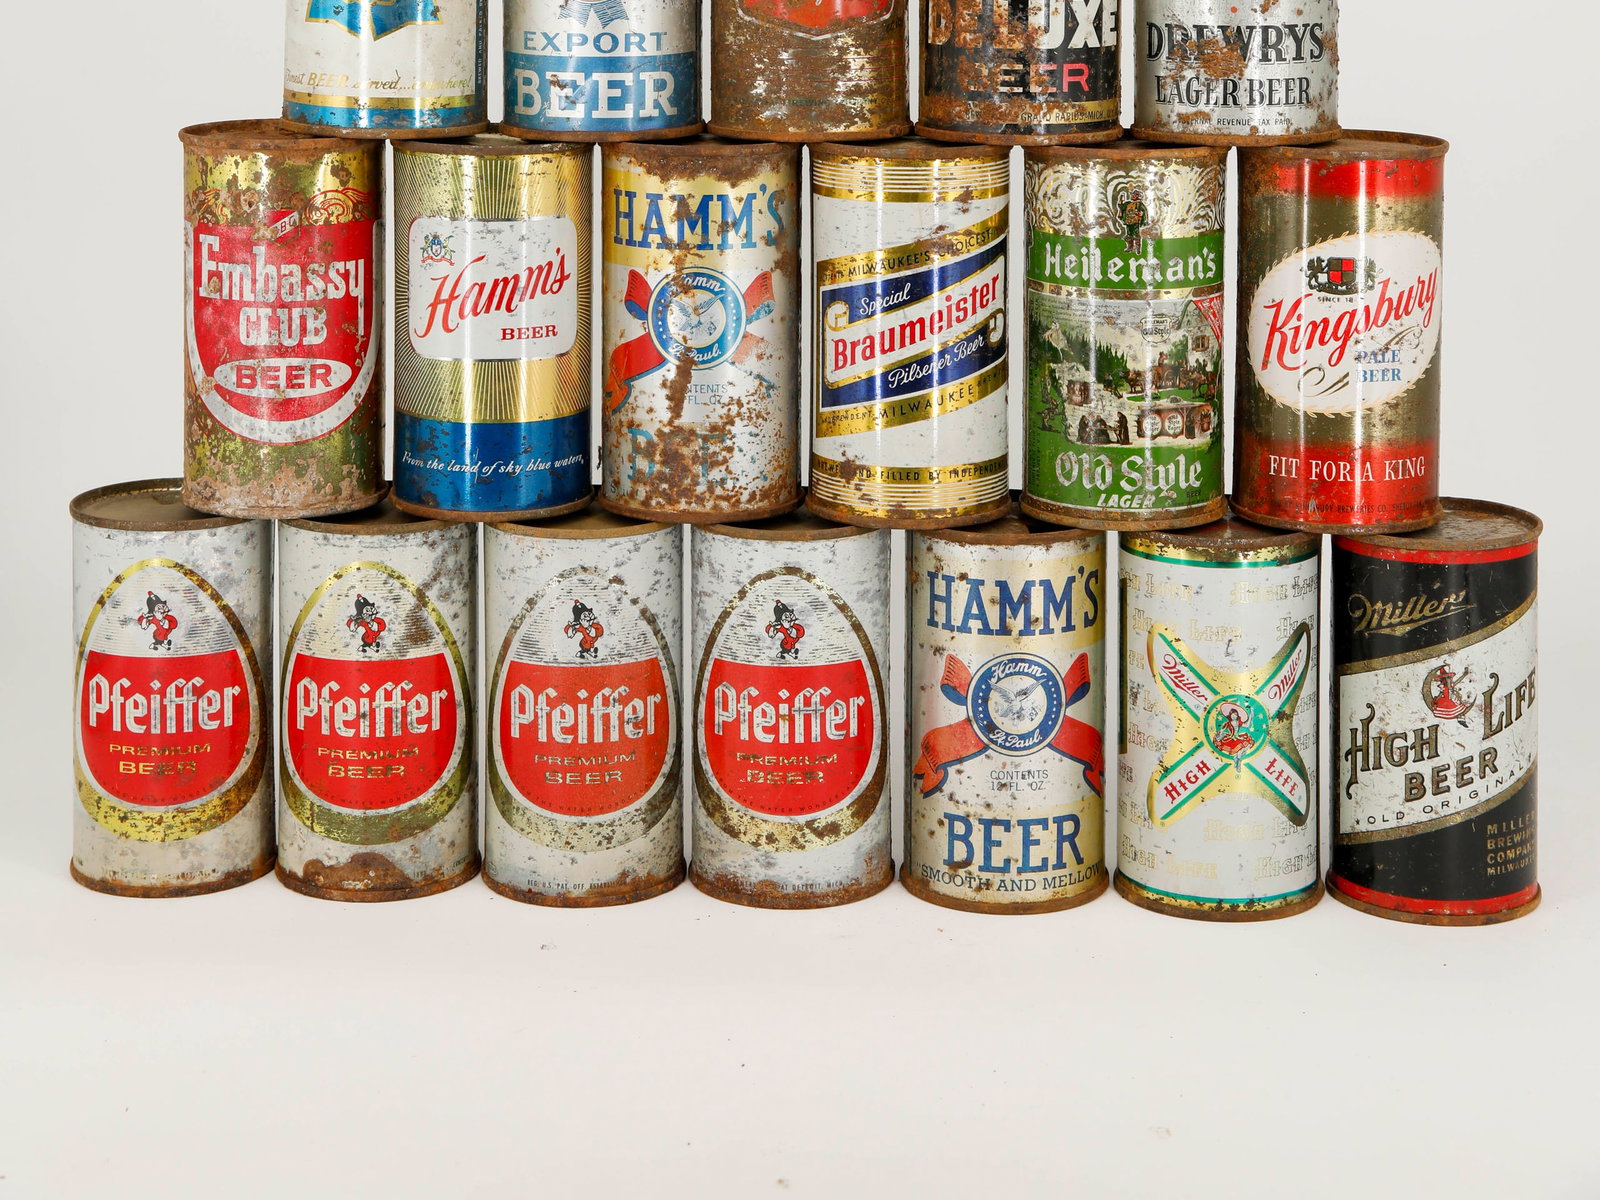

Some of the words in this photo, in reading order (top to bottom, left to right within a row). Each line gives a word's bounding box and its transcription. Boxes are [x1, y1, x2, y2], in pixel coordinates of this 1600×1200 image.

[523, 30, 668, 53] EXPORT
[308, 72, 349, 87] BEER
[514, 68, 677, 119] BEER
[956, 62, 1090, 93] BEER
[1155, 75, 1241, 108] LAGER
[1247, 76, 1312, 108] BEER
[613, 183, 785, 250] HAMM'S
[848, 251, 931, 277] MILWAUKEE'S
[1044, 241, 1216, 283] Heileman's
[199, 234, 364, 336] Embassy
[414, 247, 571, 339] Hamm's
[859, 282, 910, 316] Special
[239, 306, 327, 347] CLUB
[501, 325, 558, 340] BEER
[832, 273, 1000, 373] Braumeister
[1261, 268, 1438, 372] Kingsbury
[888, 352, 953, 389] Pilsener
[953, 334, 985, 362] Beer
[1355, 350, 1401, 364] PALE
[235, 363, 333, 390] BEER
[1357, 368, 1402, 383] BEER
[878, 384, 974, 419] MILWAUKEE
[402, 451, 424, 467] From
[426, 459, 444, 471] the
[447, 461, 481, 474] land
[482, 460, 504, 477] of
[499, 461, 523, 476] sky
[526, 459, 551, 472] blue
[880, 471, 920, 481] FILLED
[928, 471, 941, 480] BY
[1055, 450, 1113, 491] Old
[1119, 453, 1203, 499] Style
[1269, 455, 1300, 479] FIT
[1309, 460, 1351, 482] FOR
[1361, 461, 1374, 482] A
[1383, 456, 1425, 481] KING
[1097, 493, 1156, 508] LAGER
[927, 565, 1099, 637] HAMM'S
[1349, 590, 1467, 634] Miller
[991, 659, 1048, 682] Hamm
[1161, 653, 1209, 702] Miller
[1268, 649, 1303, 701] Miller
[89, 673, 241, 734] Pfeiffer
[296, 676, 448, 738] Pfeiffer
[510, 683, 662, 744] Pfeiffer
[714, 681, 865, 744] Pfeiffer
[1482, 666, 1536, 741] LIFE
[109, 743, 211, 756] PREMIUM
[317, 747, 419, 760] PREMIUM
[534, 752, 636, 767] PREMIUM
[736, 752, 838, 766] PREMIUM
[1345, 703, 1440, 800] HIGH
[119, 761, 197, 775] BEER
[328, 765, 405, 779] BEER
[545, 770, 623, 785] BEER
[746, 769, 824, 785] BEER
[990, 770, 1049, 780] CONTENTS
[1163, 760, 1211, 804] HIGH
[1265, 758, 1300, 797] LIFE
[1405, 746, 1498, 803] BEER
[1009, 782, 1025, 792] FL.
[1030, 781, 1046, 791] OZ.
[1367, 811, 1405, 824] OLD
[1422, 763, 1525, 814] ORIGINAL
[943, 811, 1084, 874] BEER
[996, 879, 1037, 892] AND
[1042, 863, 1100, 890] MELLOW
